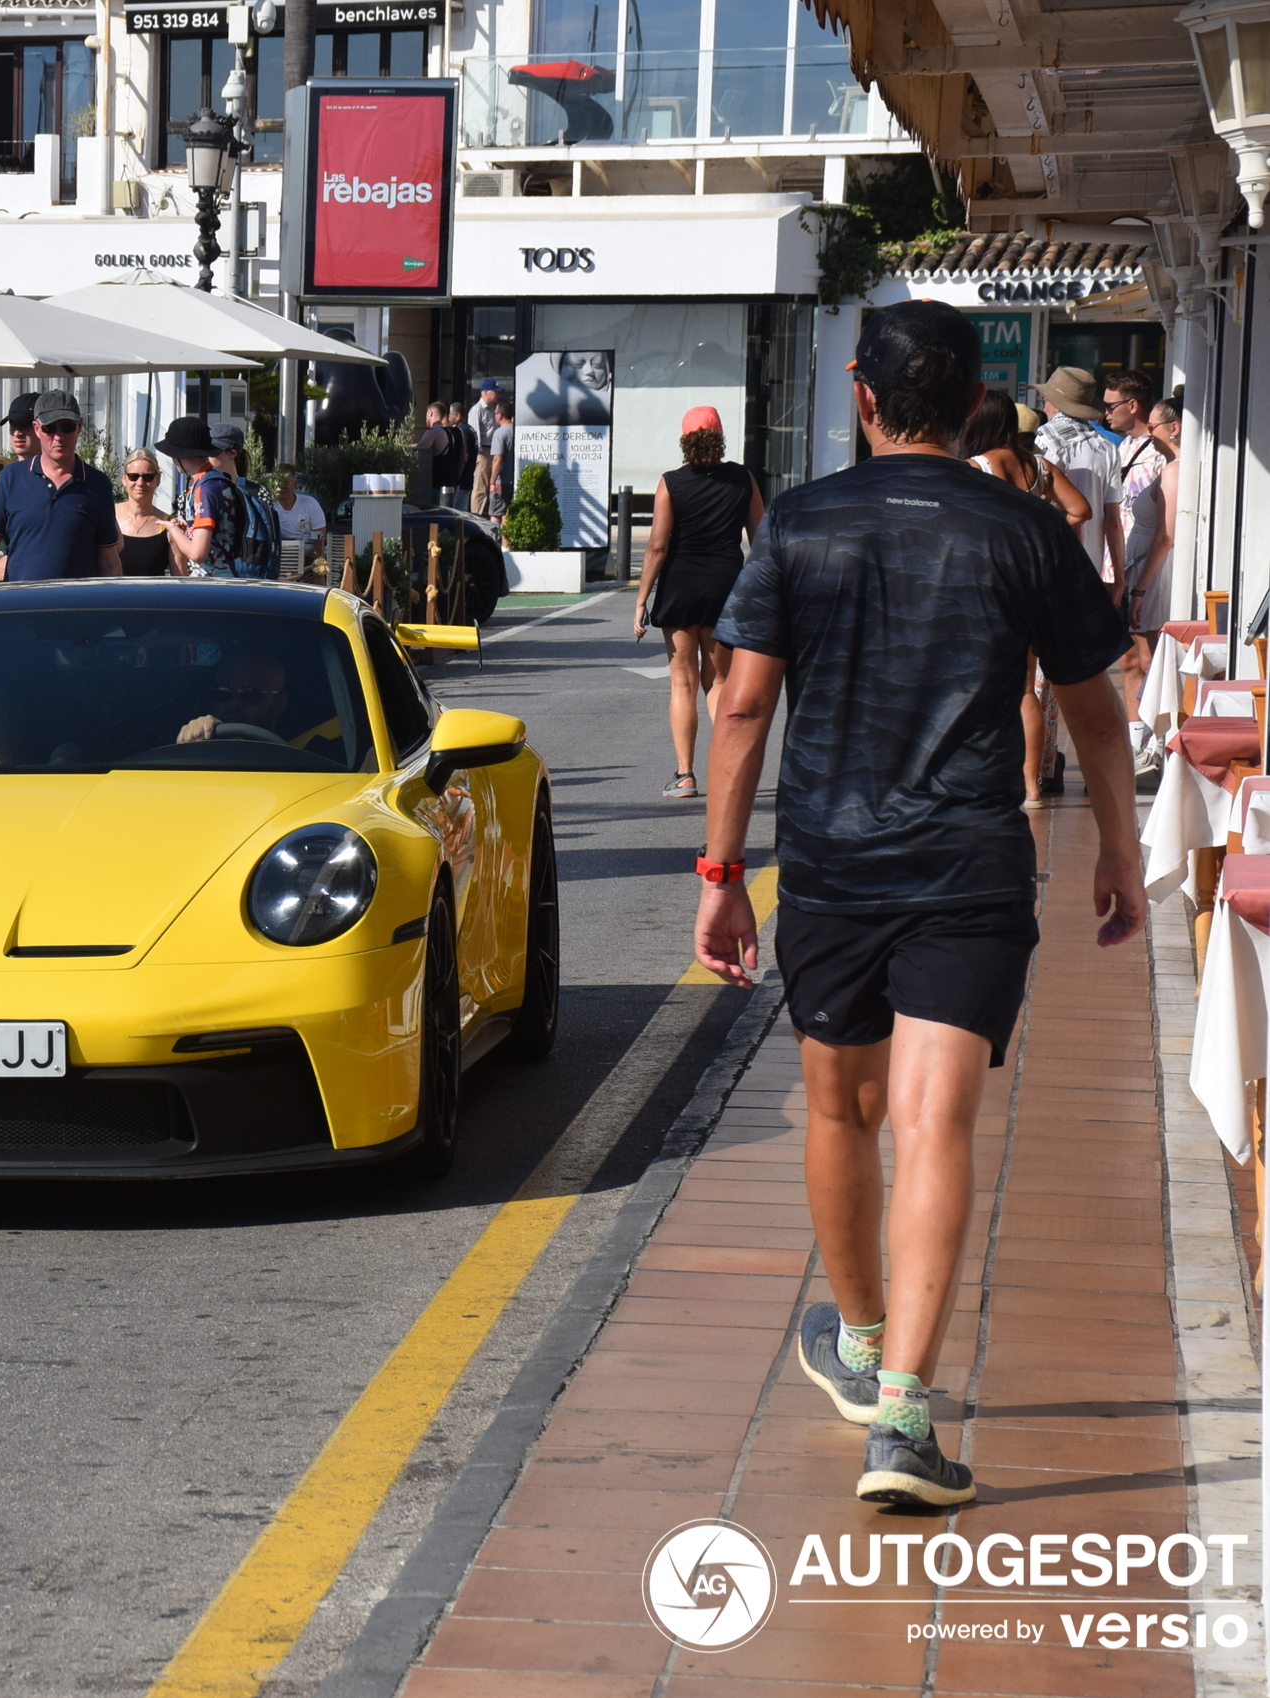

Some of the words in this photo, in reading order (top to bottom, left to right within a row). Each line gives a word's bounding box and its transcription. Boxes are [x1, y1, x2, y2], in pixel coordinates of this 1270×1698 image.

[133, 14, 159, 29] 951
[162, 13, 188, 28] 319
[191, 12, 219, 28] 814
[335, 6, 437, 22] benchlaw.es
[324, 171, 346, 183] Las
[323, 176, 433, 209] rebajas
[94, 254, 145, 268] GOLDEN
[150, 254, 192, 268] GOOSE
[518, 247, 595, 273] TOD'S
[978, 281, 1084, 301] CHANGE
[979, 320, 1022, 344] TM
[993, 346, 1023, 358] cash
[521, 431, 559, 441] JIMÉNEZ
[562, 432, 604, 441] DEREDIA
[570, 444, 603, 452] 10.08.23
[886, 497, 903, 505] new
[904, 498, 940, 508] balance
